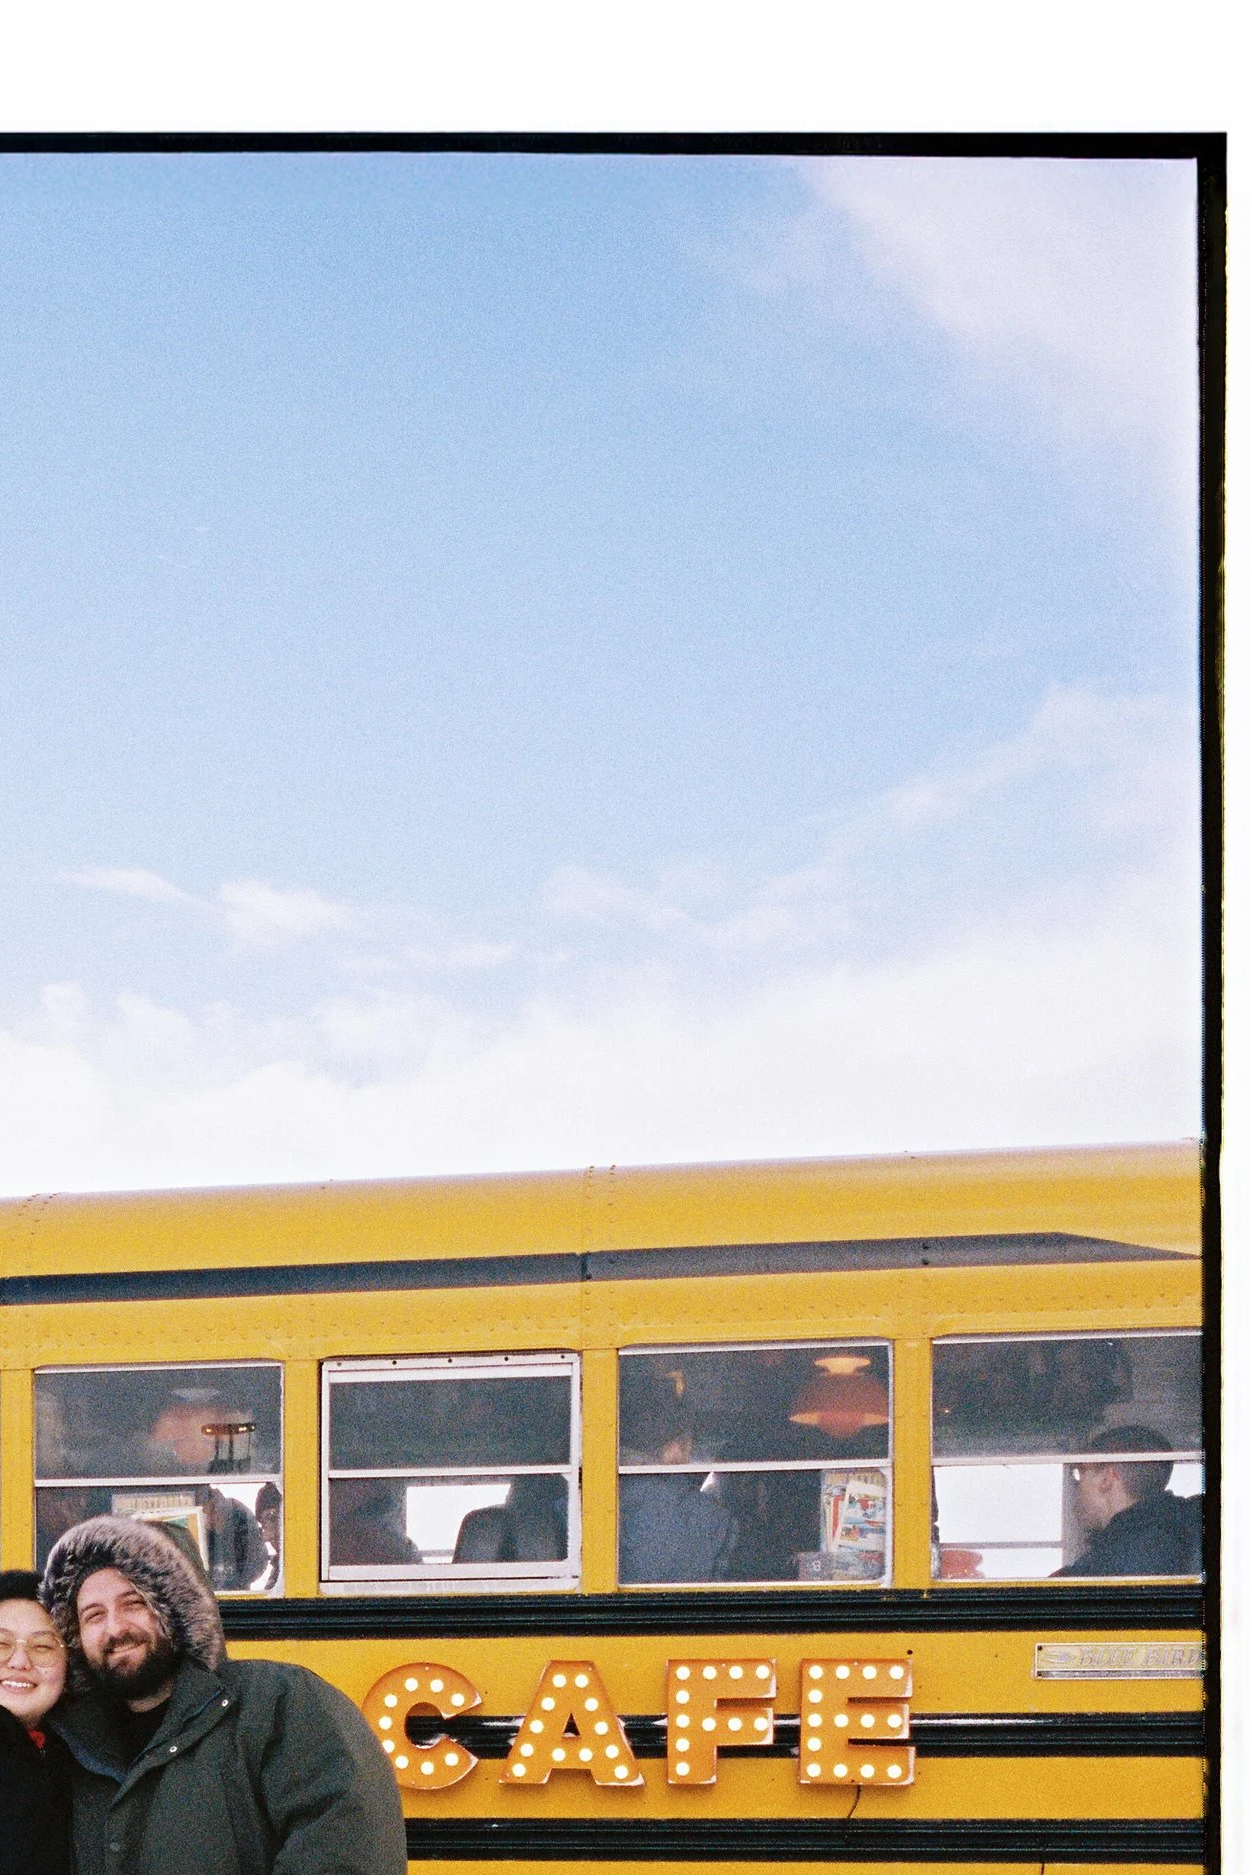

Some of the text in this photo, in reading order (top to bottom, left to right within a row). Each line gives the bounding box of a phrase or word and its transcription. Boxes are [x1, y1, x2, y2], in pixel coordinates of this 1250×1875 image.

[1079, 1647, 1204, 1666] BLUE BIRD
[363, 1658, 915, 1790] CAFE
